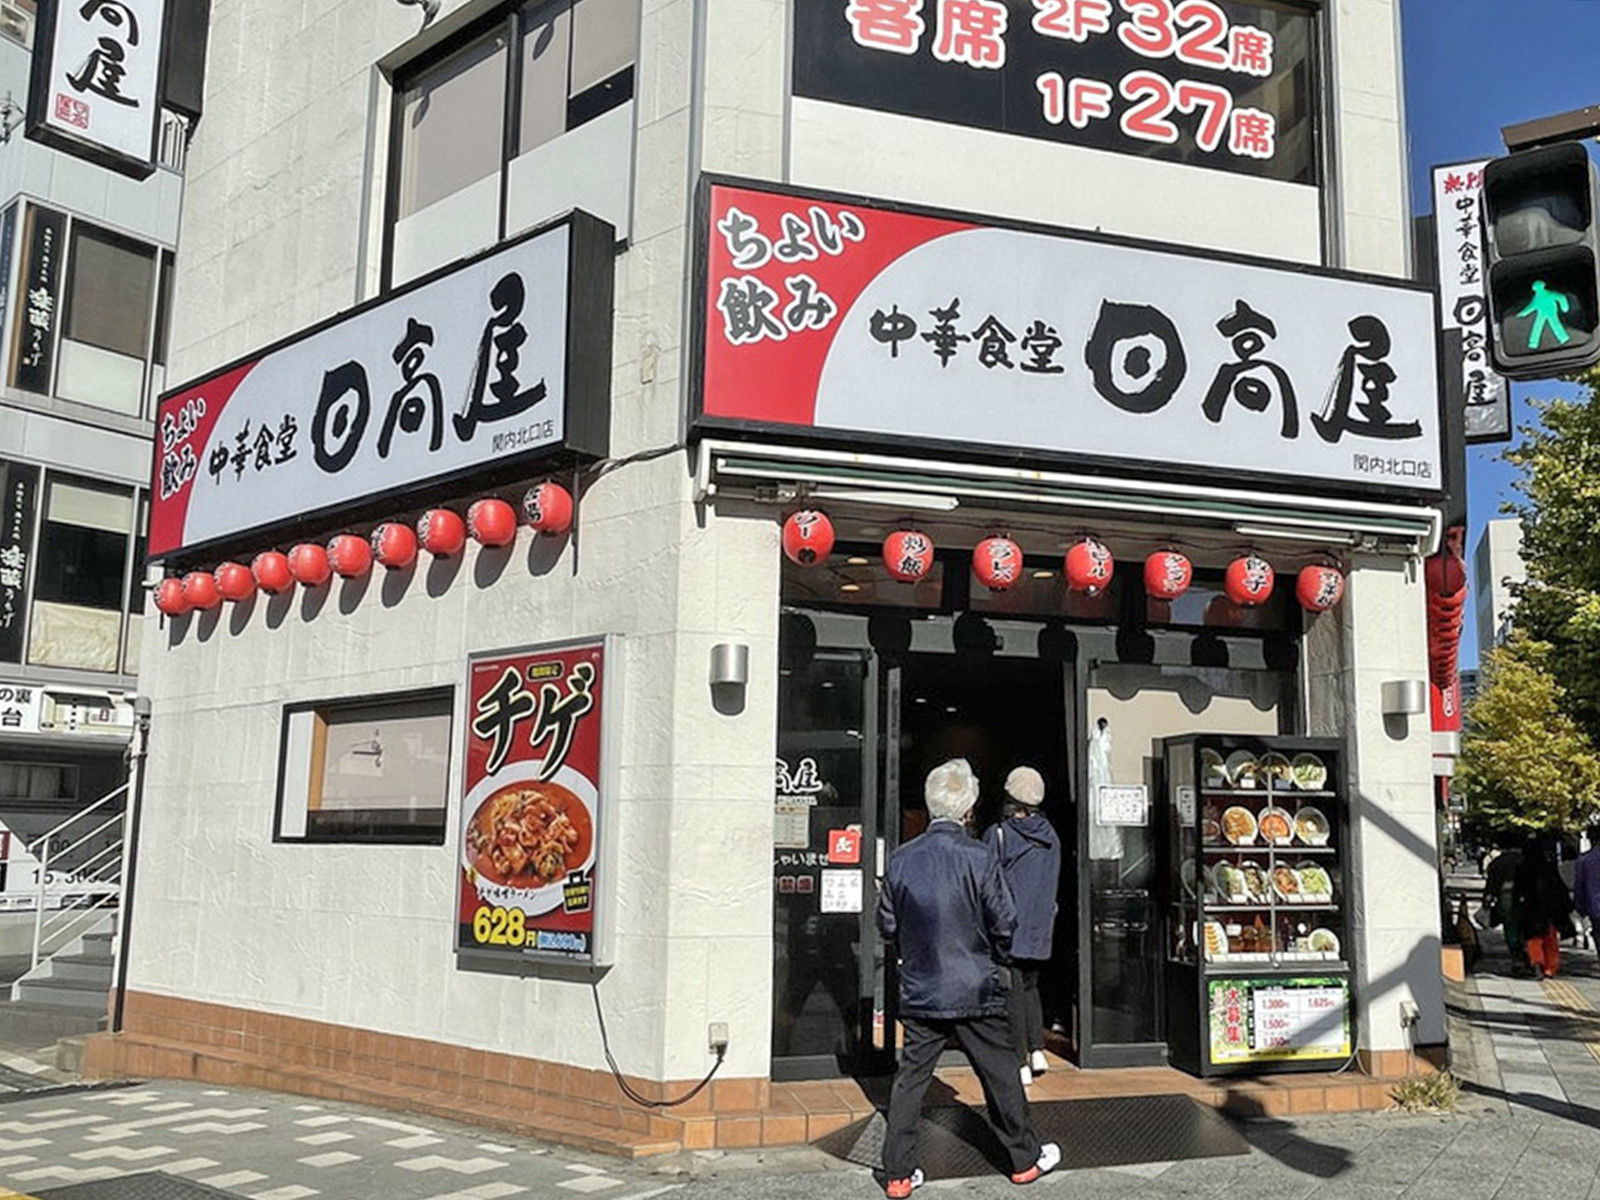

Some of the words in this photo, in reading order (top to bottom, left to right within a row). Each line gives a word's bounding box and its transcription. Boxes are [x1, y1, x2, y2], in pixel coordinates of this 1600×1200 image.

[1036, 72, 1113, 128] 1F
[1118, 69, 1276, 159] 27席
[717, 207, 865, 269] ちょい
[716, 274, 838, 345] 飲み
[208, 414, 298, 486] 中華食堂
[311, 271, 548, 474] 日高屋
[869, 297, 1064, 374] 中華食堂
[1084, 297, 1424, 444] 日高屋
[160, 397, 206, 454] ちょい
[160, 443, 197, 501] 飲み
[1352, 453, 1433, 479] 関内北口店
[471, 661, 594, 781] チゲ
